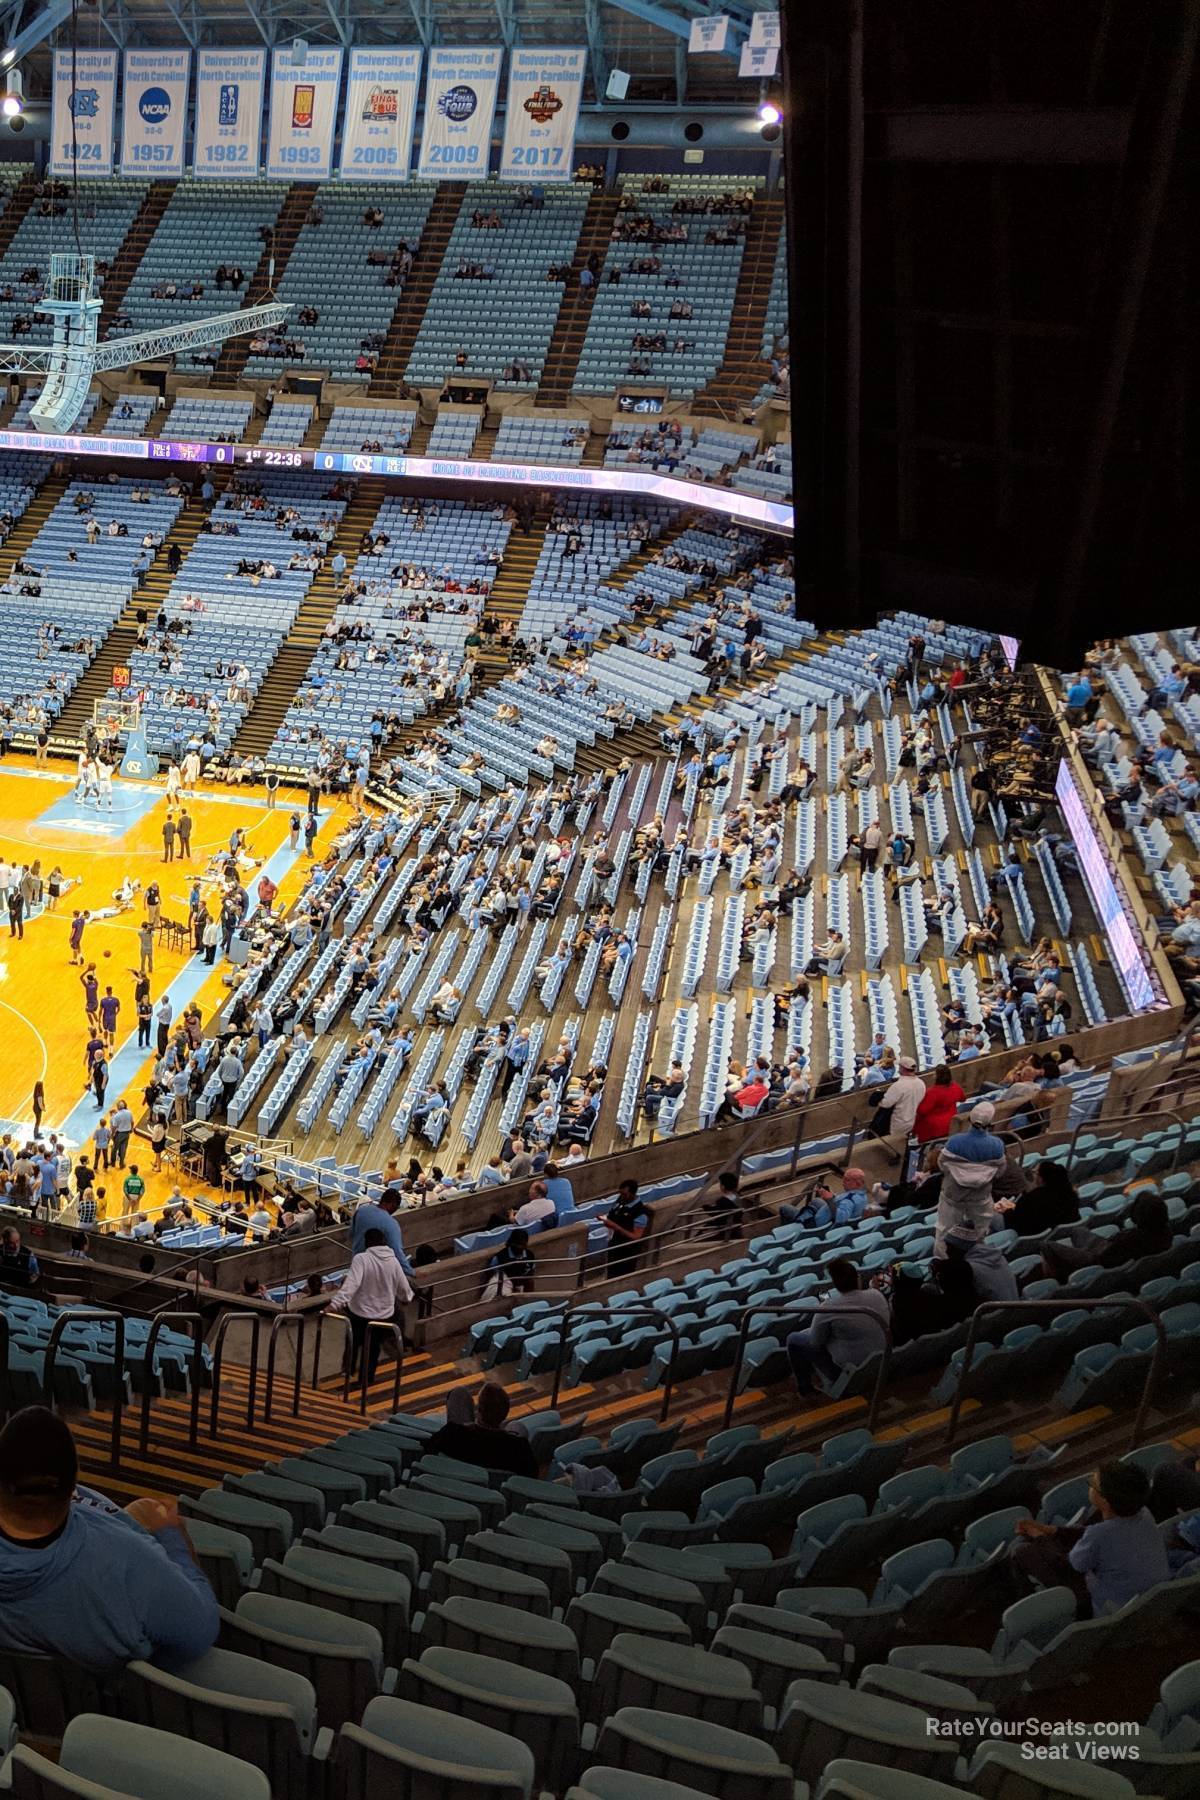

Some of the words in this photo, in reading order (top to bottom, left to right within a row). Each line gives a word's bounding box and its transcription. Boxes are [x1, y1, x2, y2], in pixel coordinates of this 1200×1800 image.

[103, 55, 112, 66] of
[130, 55, 173, 67] University
[175, 55, 184, 66] of
[204, 55, 247, 67] University
[249, 55, 259, 66] of
[325, 55, 335, 66] of
[357, 55, 400, 67] University
[402, 54, 414, 66] of
[436, 53, 482, 66] University
[484, 53, 495, 65] of
[519, 53, 566, 66] University
[568, 53, 578, 65] of
[80, 71, 114, 81] Carolina
[127, 71, 149, 81] North
[150, 71, 186, 82] Carolina
[201, 71, 223, 81] North
[225, 71, 260, 82] Carolina
[275, 71, 299, 81] North
[301, 71, 337, 82] Carolina
[352, 71, 377, 82] North
[378, 71, 416, 82] Carolina
[432, 69, 457, 80] North
[459, 69, 497, 80] Carolina
[513, 70, 540, 82] North
[541, 70, 581, 82] Carolina
[371, 95, 397, 104] FINAL
[453, 93, 473, 102] FINAL
[141, 104, 171, 116] NCAA
[373, 103, 397, 113] FOUR
[445, 100, 473, 112] FOUR
[63, 143, 102, 161] 1924
[131, 144, 174, 162] 1957
[205, 144, 249, 162] 1982
[280, 146, 321, 164] 1993
[353, 146, 398, 164] 2005
[429, 145, 479, 163] 2009
[511, 147, 563, 166] 2017
[26, 436, 42, 446] THE
[44, 437, 66, 449] DEAN
[80, 440, 108, 452] SMITH
[110, 442, 145, 455] CENTER
[216, 448, 225, 462] 0
[265, 451, 302, 467] 22:36
[324, 454, 334, 469] 0
[432, 462, 460, 475] HOME
[479, 467, 528, 480] CAROLINA
[530, 470, 593, 485] BASKETBALL
